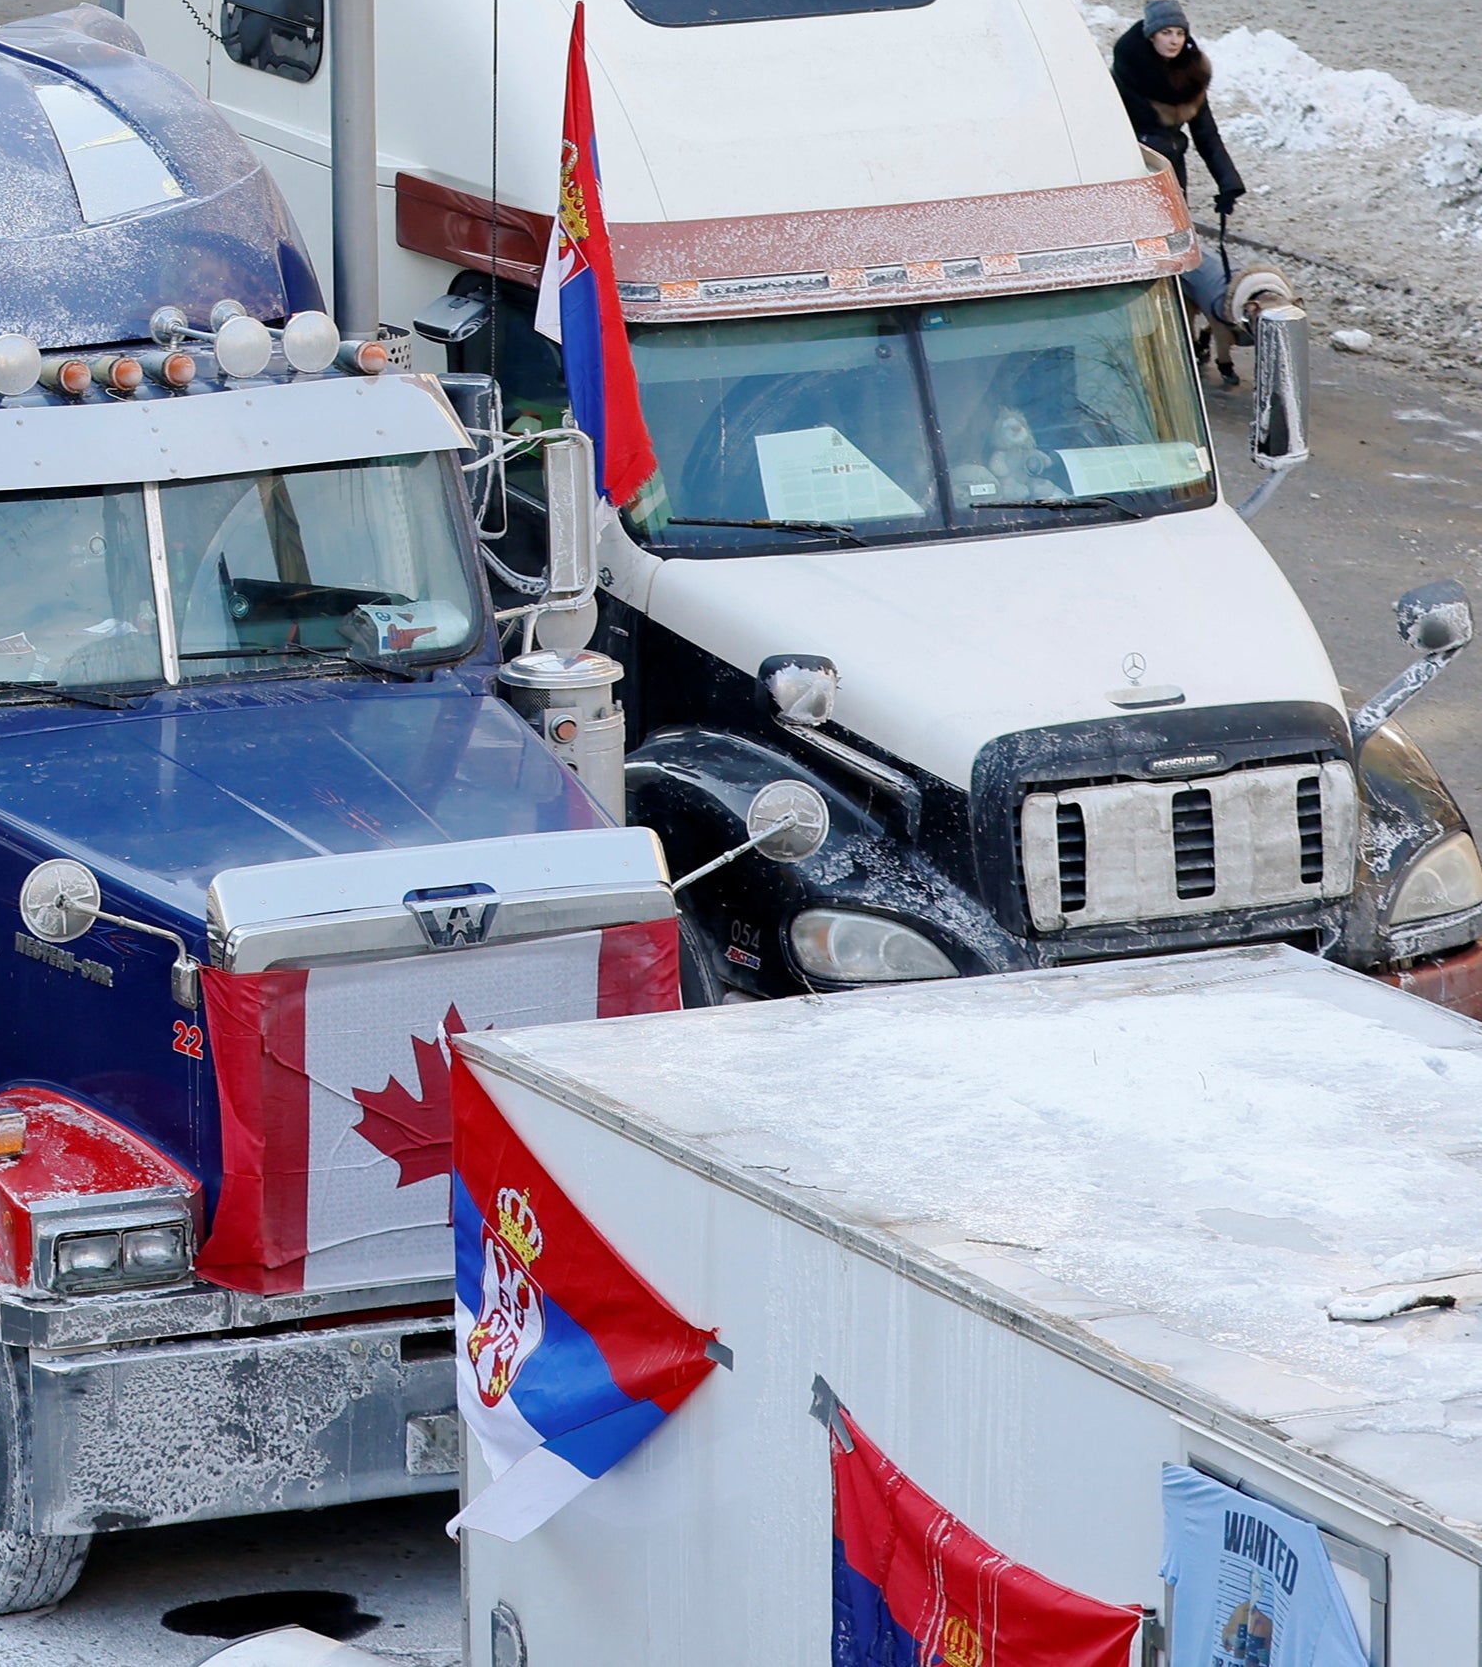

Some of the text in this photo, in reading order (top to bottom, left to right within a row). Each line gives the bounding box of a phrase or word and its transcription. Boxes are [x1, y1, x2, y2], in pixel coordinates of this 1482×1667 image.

[731, 919, 760, 950] 054
[173, 1020, 203, 1060] 22
[1224, 1510, 1299, 1596] WANTED
